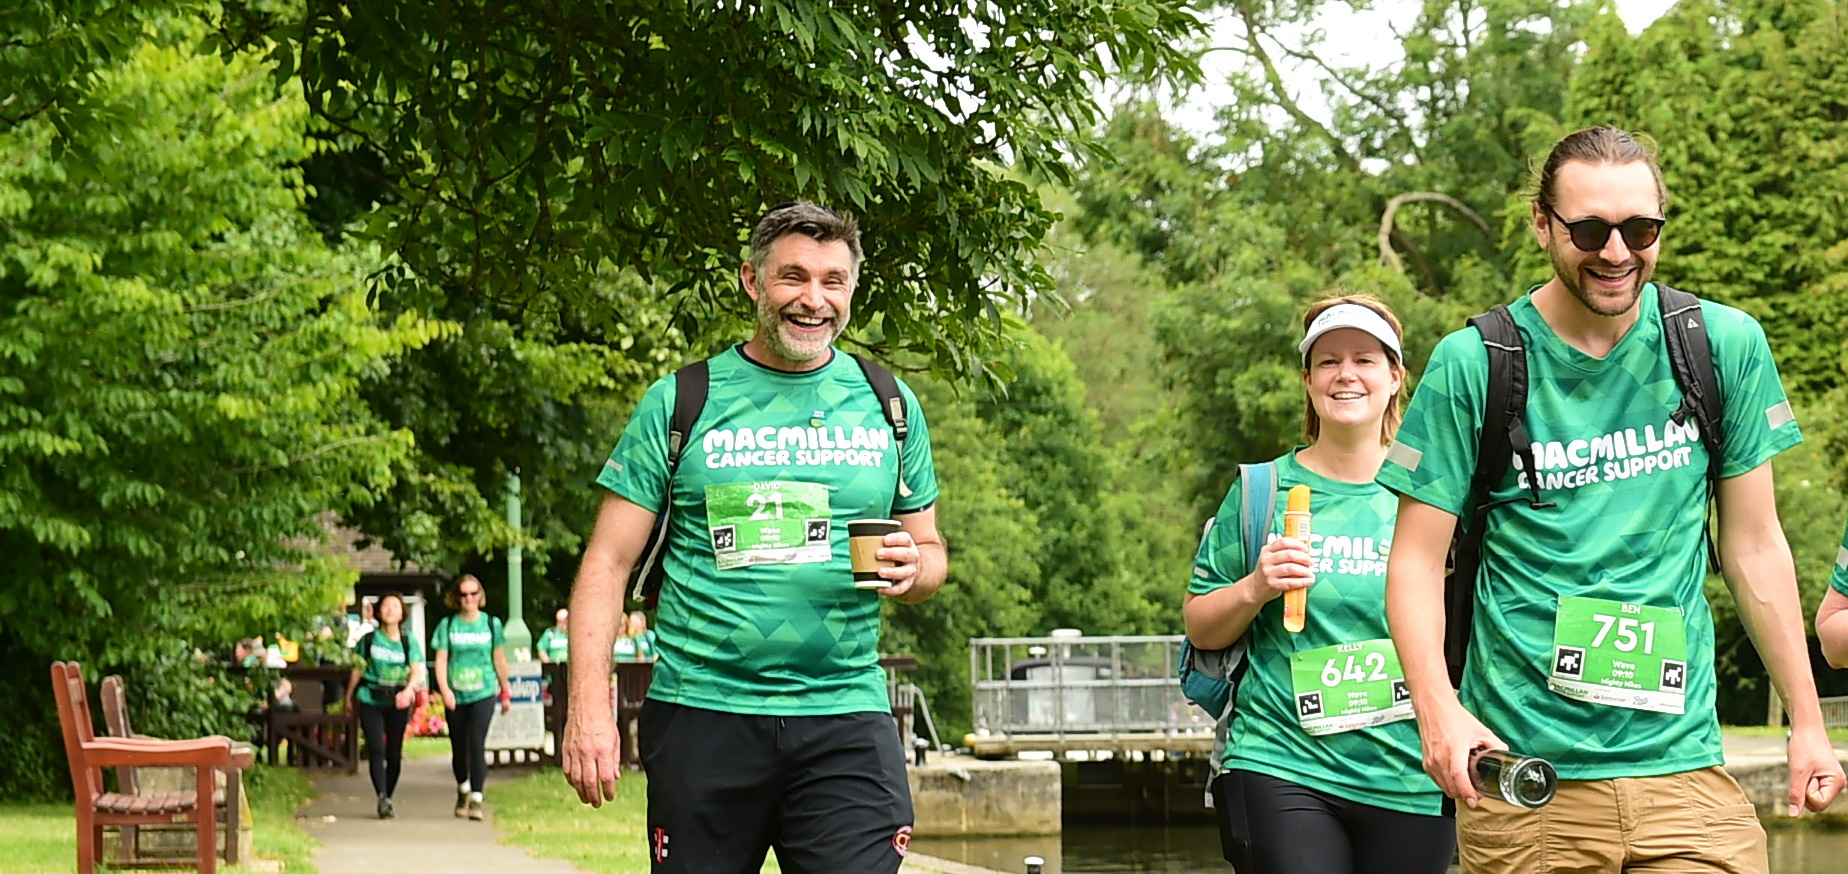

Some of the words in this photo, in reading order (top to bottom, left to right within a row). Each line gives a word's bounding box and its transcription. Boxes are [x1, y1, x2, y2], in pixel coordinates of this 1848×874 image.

[702, 425, 889, 453] MACMILLAN
[705, 451, 791, 468] CANCER
[795, 449, 884, 467] SUPPORT
[1603, 446, 1692, 482] SUPPORT
[753, 482, 781, 491] DAVID
[747, 493, 784, 521] 21
[1337, 558, 1388, 577] SUPP
[1621, 603, 1642, 615] BEN
[1590, 613, 1655, 655] 751
[1337, 642, 1364, 653] KELLY
[1321, 652, 1388, 687] 642
[1612, 659, 1636, 671] Wave
[1611, 669, 1635, 680] 09:10
[1600, 678, 1624, 688] Mighty
[1346, 691, 1368, 699] Wave
